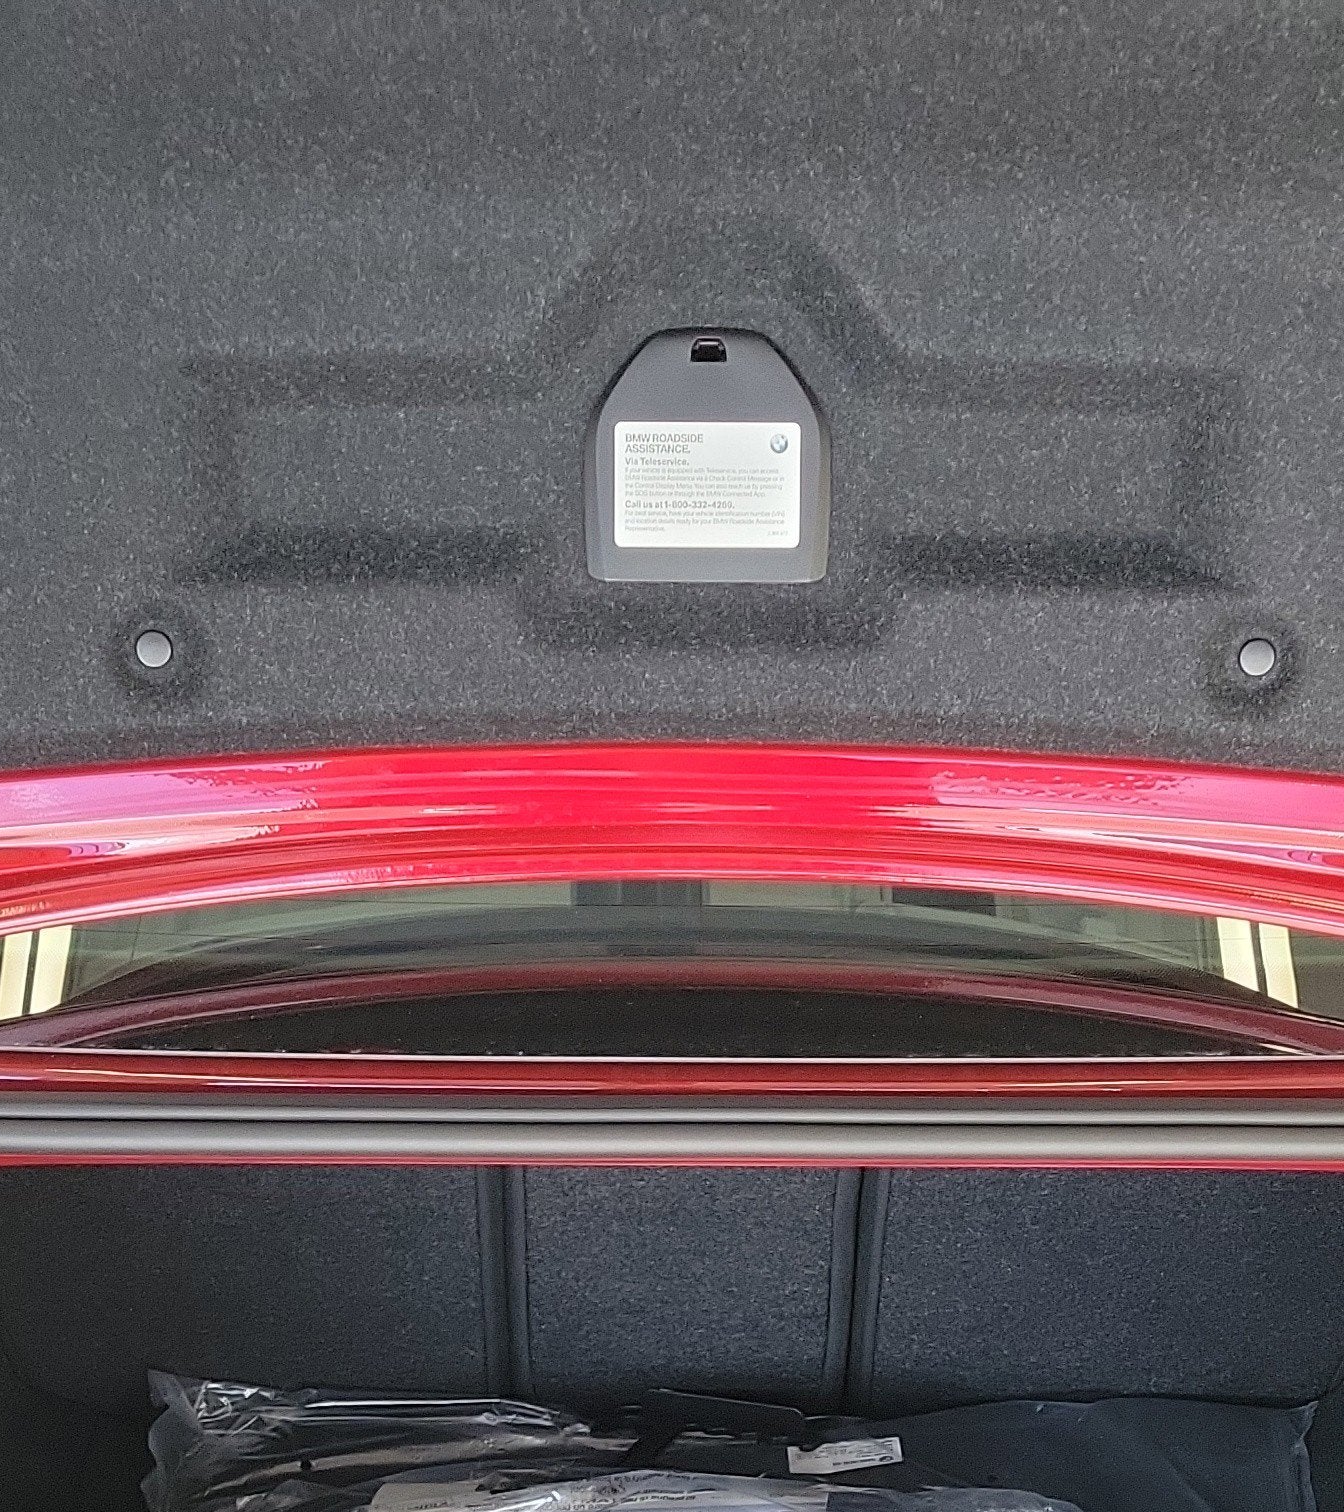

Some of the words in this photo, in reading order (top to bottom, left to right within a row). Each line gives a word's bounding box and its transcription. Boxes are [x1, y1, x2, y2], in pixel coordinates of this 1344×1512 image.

[625, 433, 651, 442] BMW
[652, 433, 704, 443] ROADSIDE
[625, 444, 690, 454] ASSISTANCE.
[625, 500, 642, 508] Call
